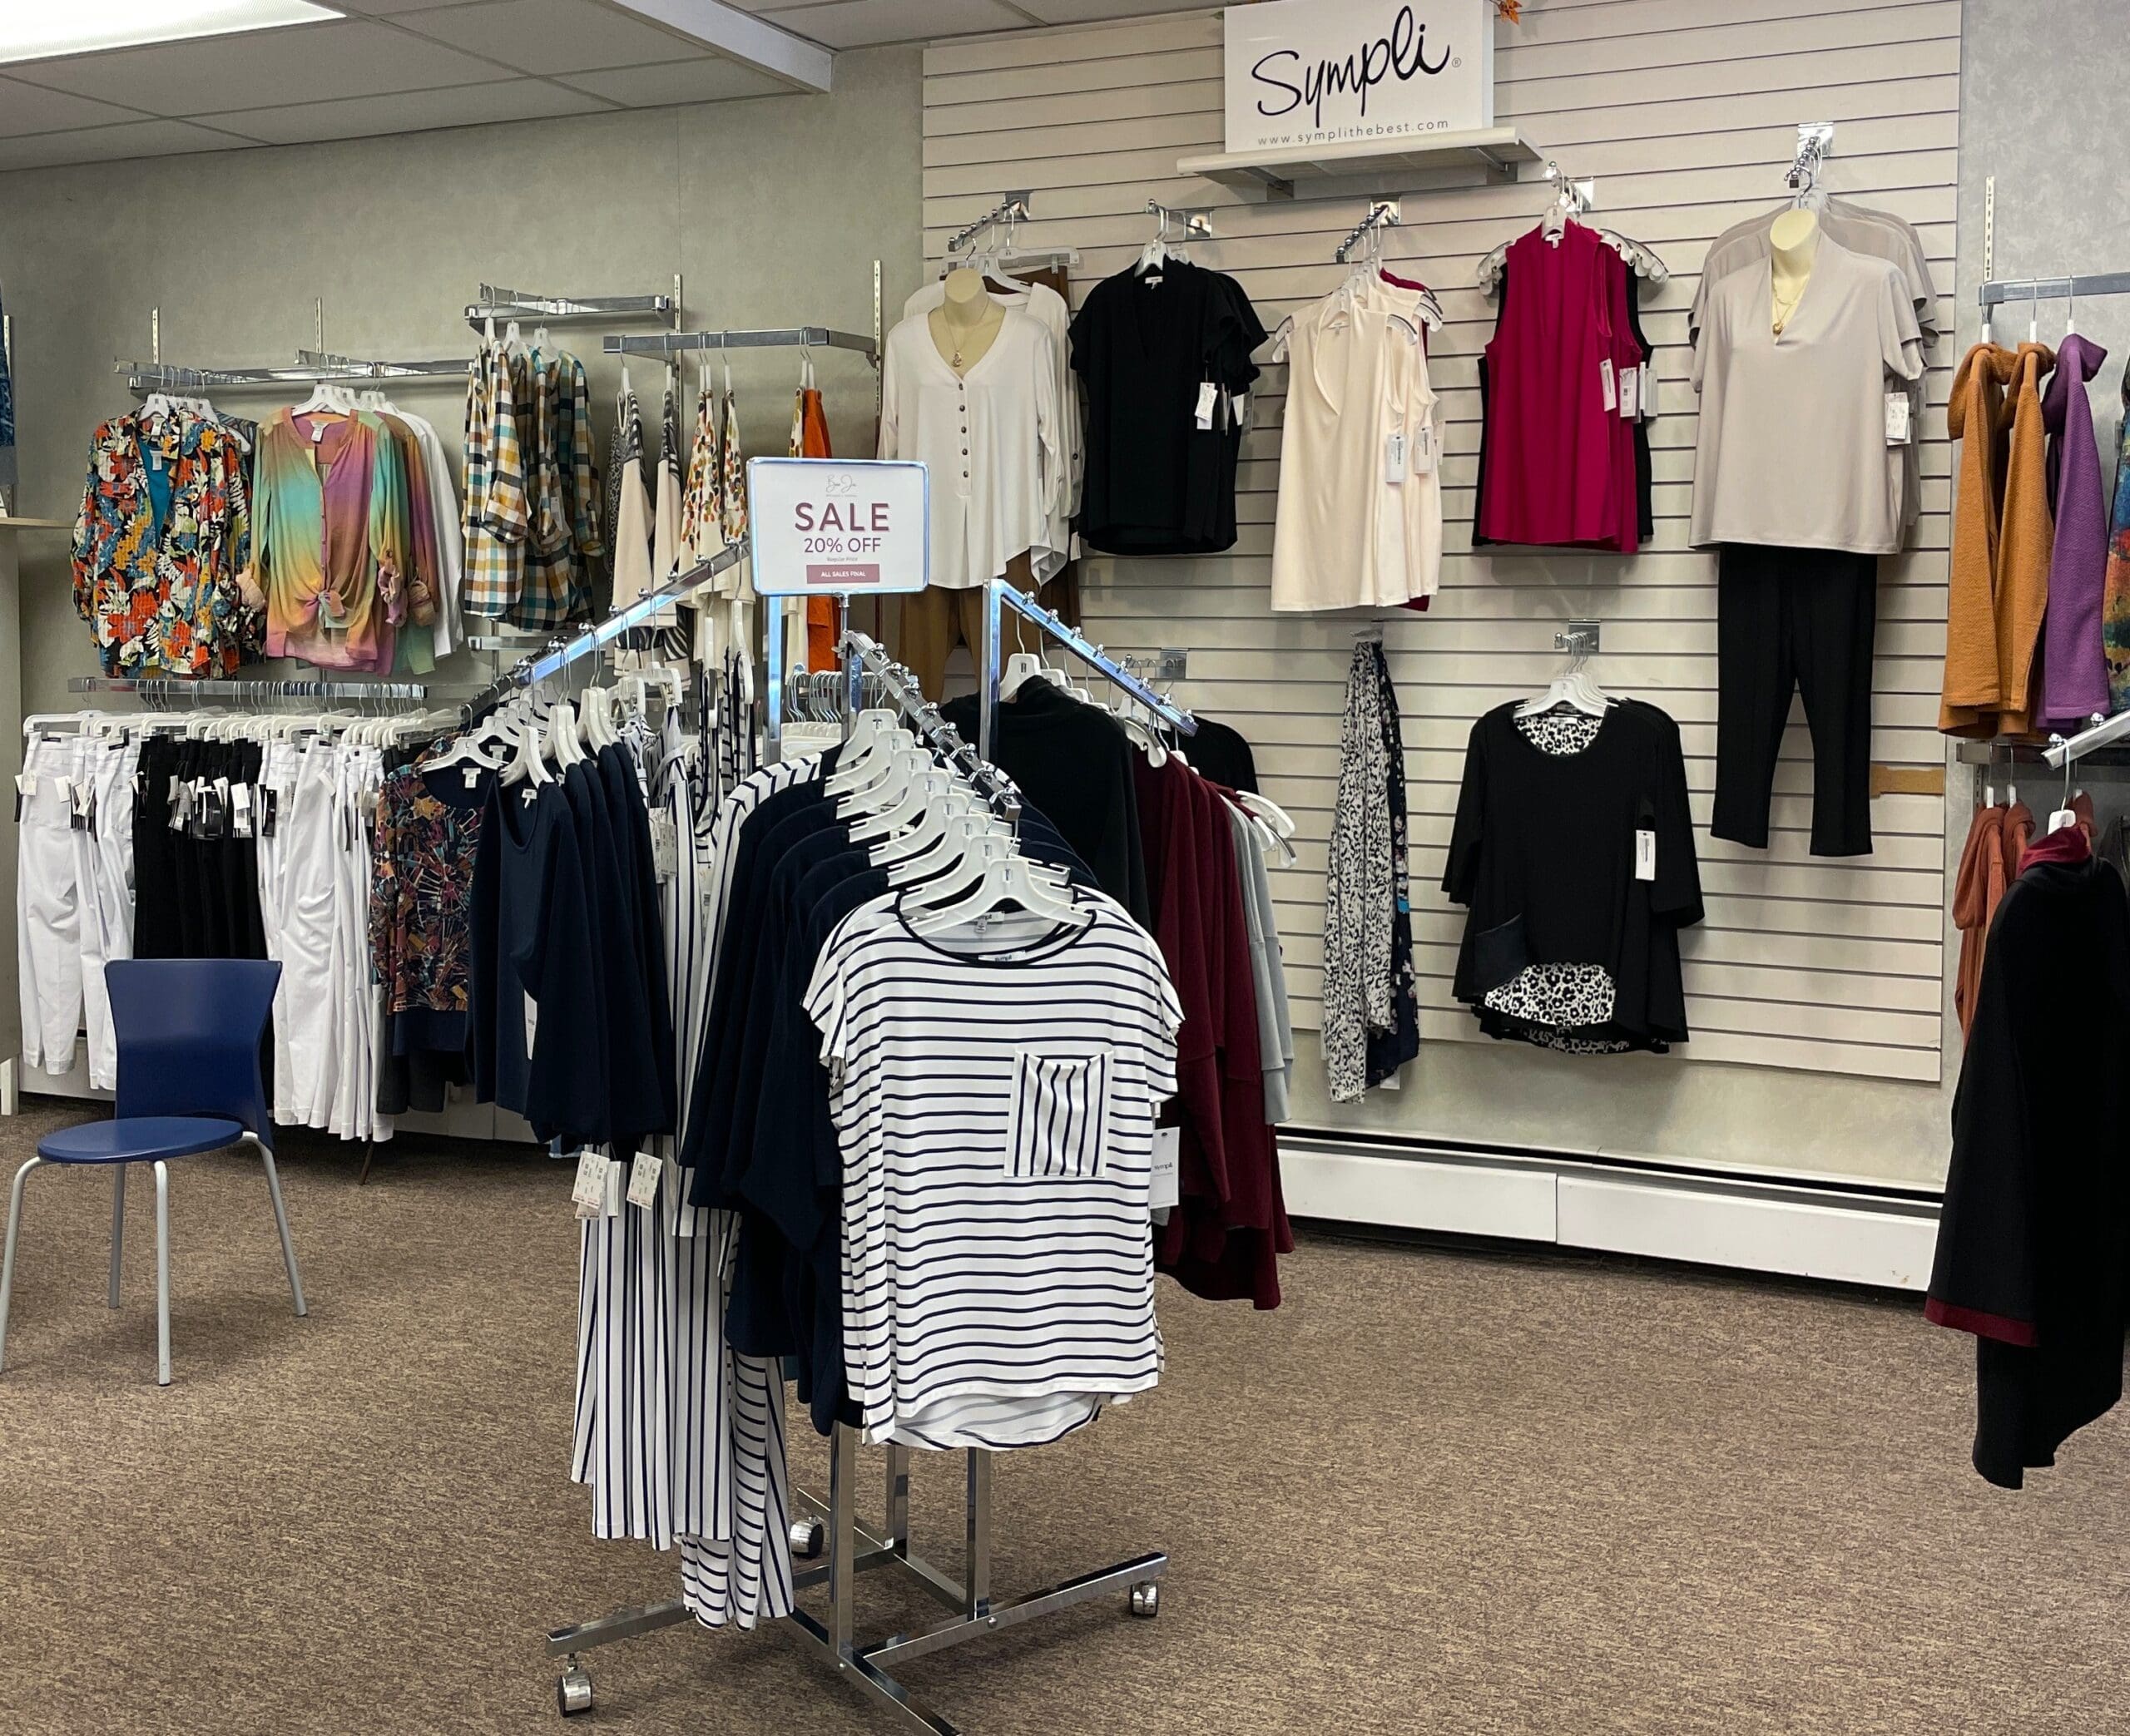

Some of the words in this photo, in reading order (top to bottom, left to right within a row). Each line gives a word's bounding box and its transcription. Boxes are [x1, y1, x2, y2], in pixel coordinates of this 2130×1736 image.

[1251, 4, 1451, 128] Sympli
[1258, 118, 1450, 146] www.symplithebest.com
[795, 502, 890, 532] SALE
[804, 538, 843, 553] 20%
[847, 537, 882, 553] OFF
